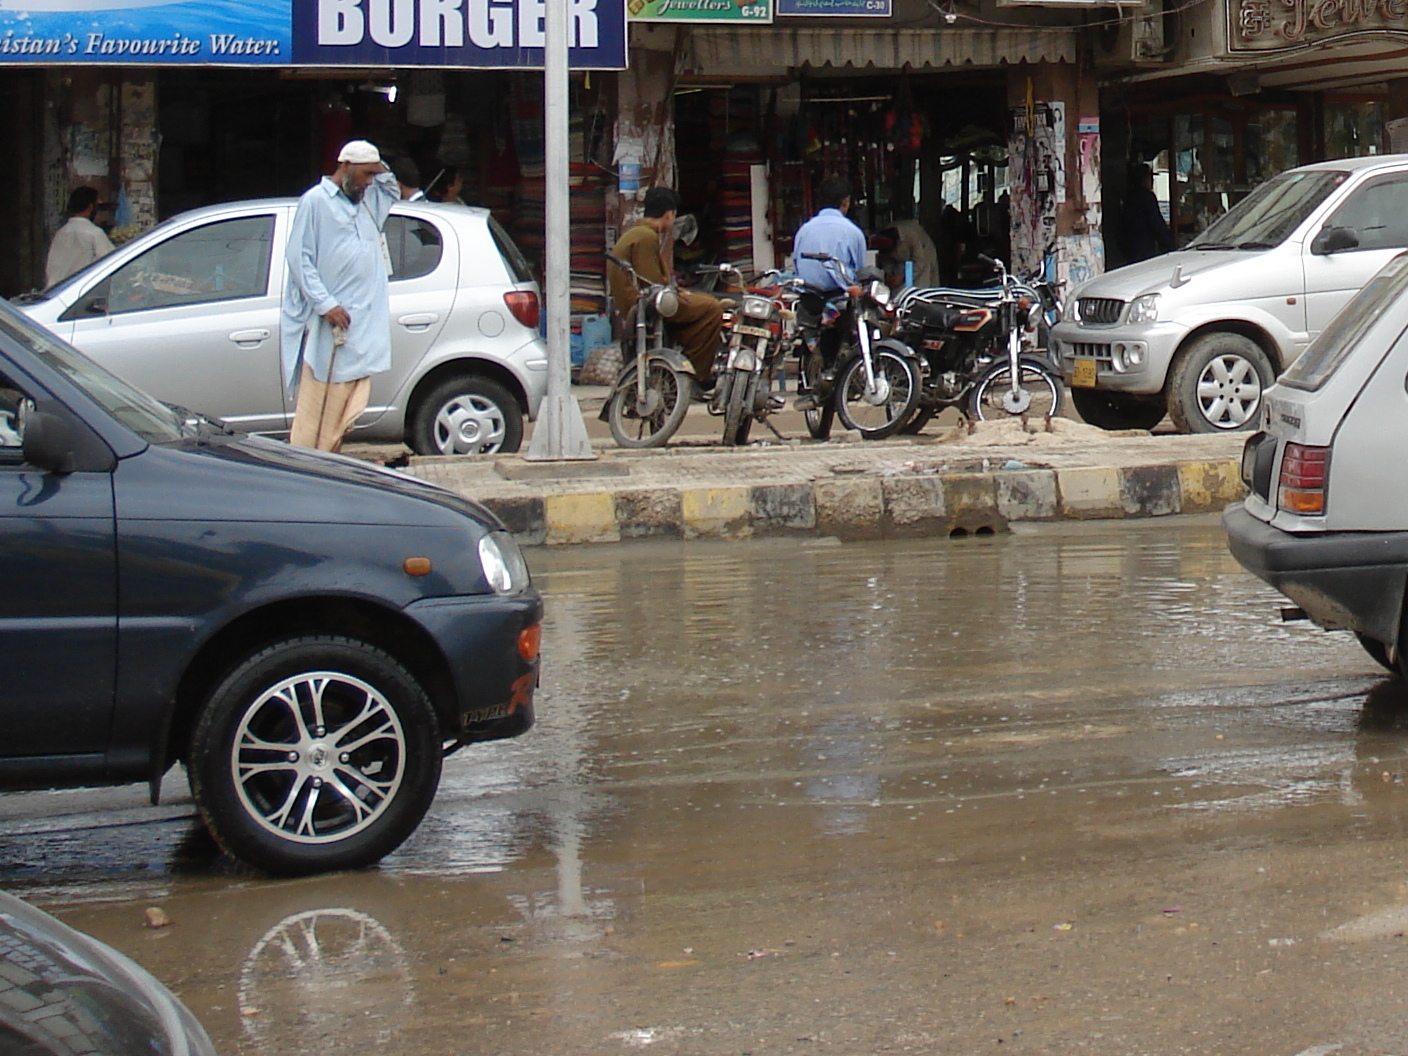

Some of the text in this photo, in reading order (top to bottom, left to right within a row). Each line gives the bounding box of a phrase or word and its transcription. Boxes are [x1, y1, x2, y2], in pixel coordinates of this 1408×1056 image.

[742, 6, 767, 18] G-92
[84, 33, 201, 55] Favourite
[209, 34, 280, 55] Water.
